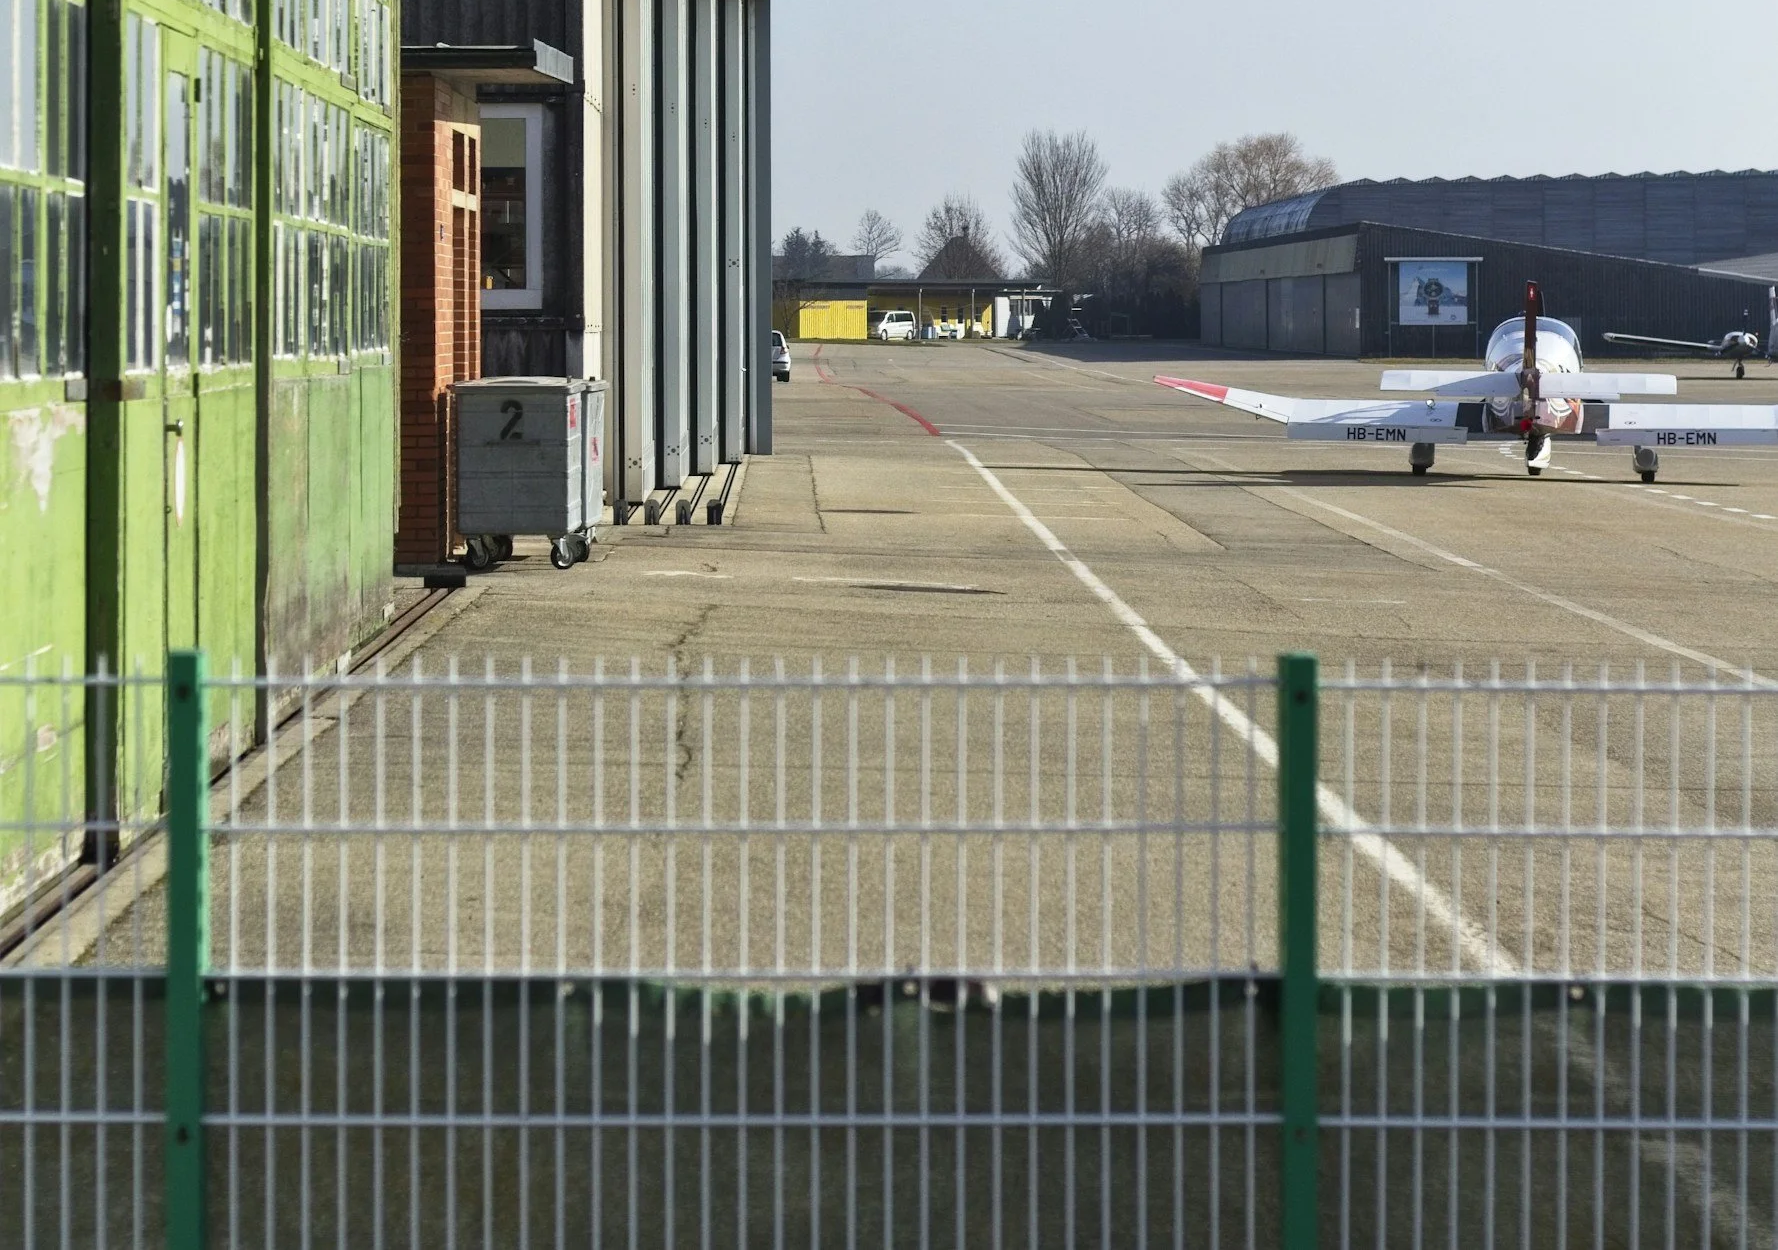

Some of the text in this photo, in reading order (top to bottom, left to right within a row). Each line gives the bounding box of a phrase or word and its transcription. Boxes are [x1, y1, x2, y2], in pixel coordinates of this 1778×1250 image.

[501, 399, 523, 440] 2
[1347, 427, 1406, 441] HB-EMN
[1657, 432, 1717, 445] HB-EMN
